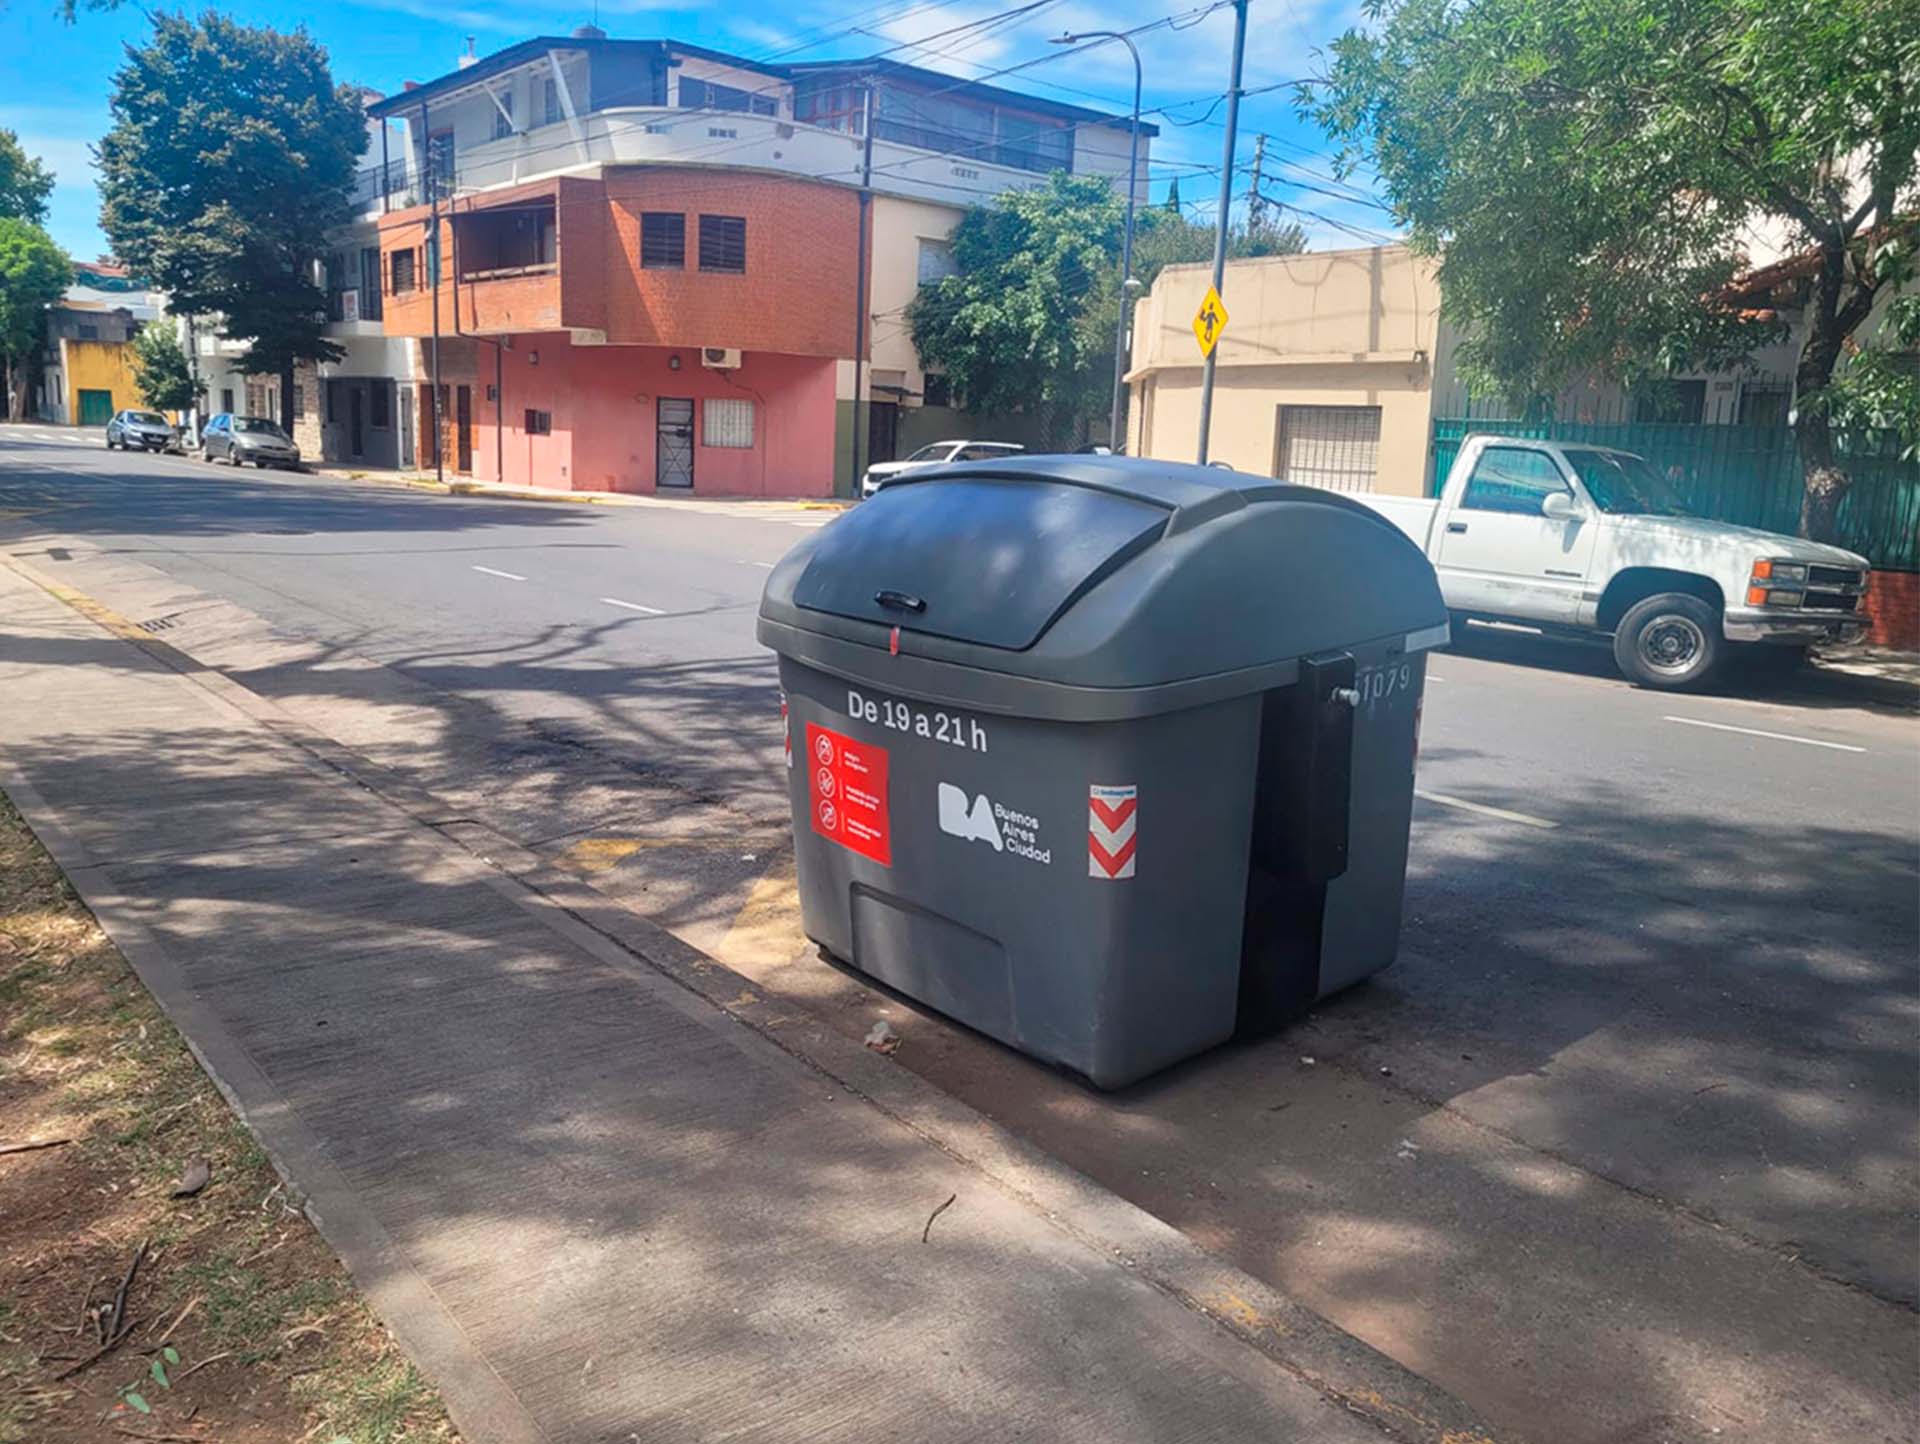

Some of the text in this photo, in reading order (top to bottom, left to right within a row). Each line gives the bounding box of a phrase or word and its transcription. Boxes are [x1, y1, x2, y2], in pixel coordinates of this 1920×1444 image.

[848, 691, 988, 752] De 19 a 21 h
[938, 781, 1004, 852] BA
[994, 803, 1039, 829] Buenos
[1002, 822, 1036, 843] Aires
[1006, 839, 1051, 865] Ciudad
